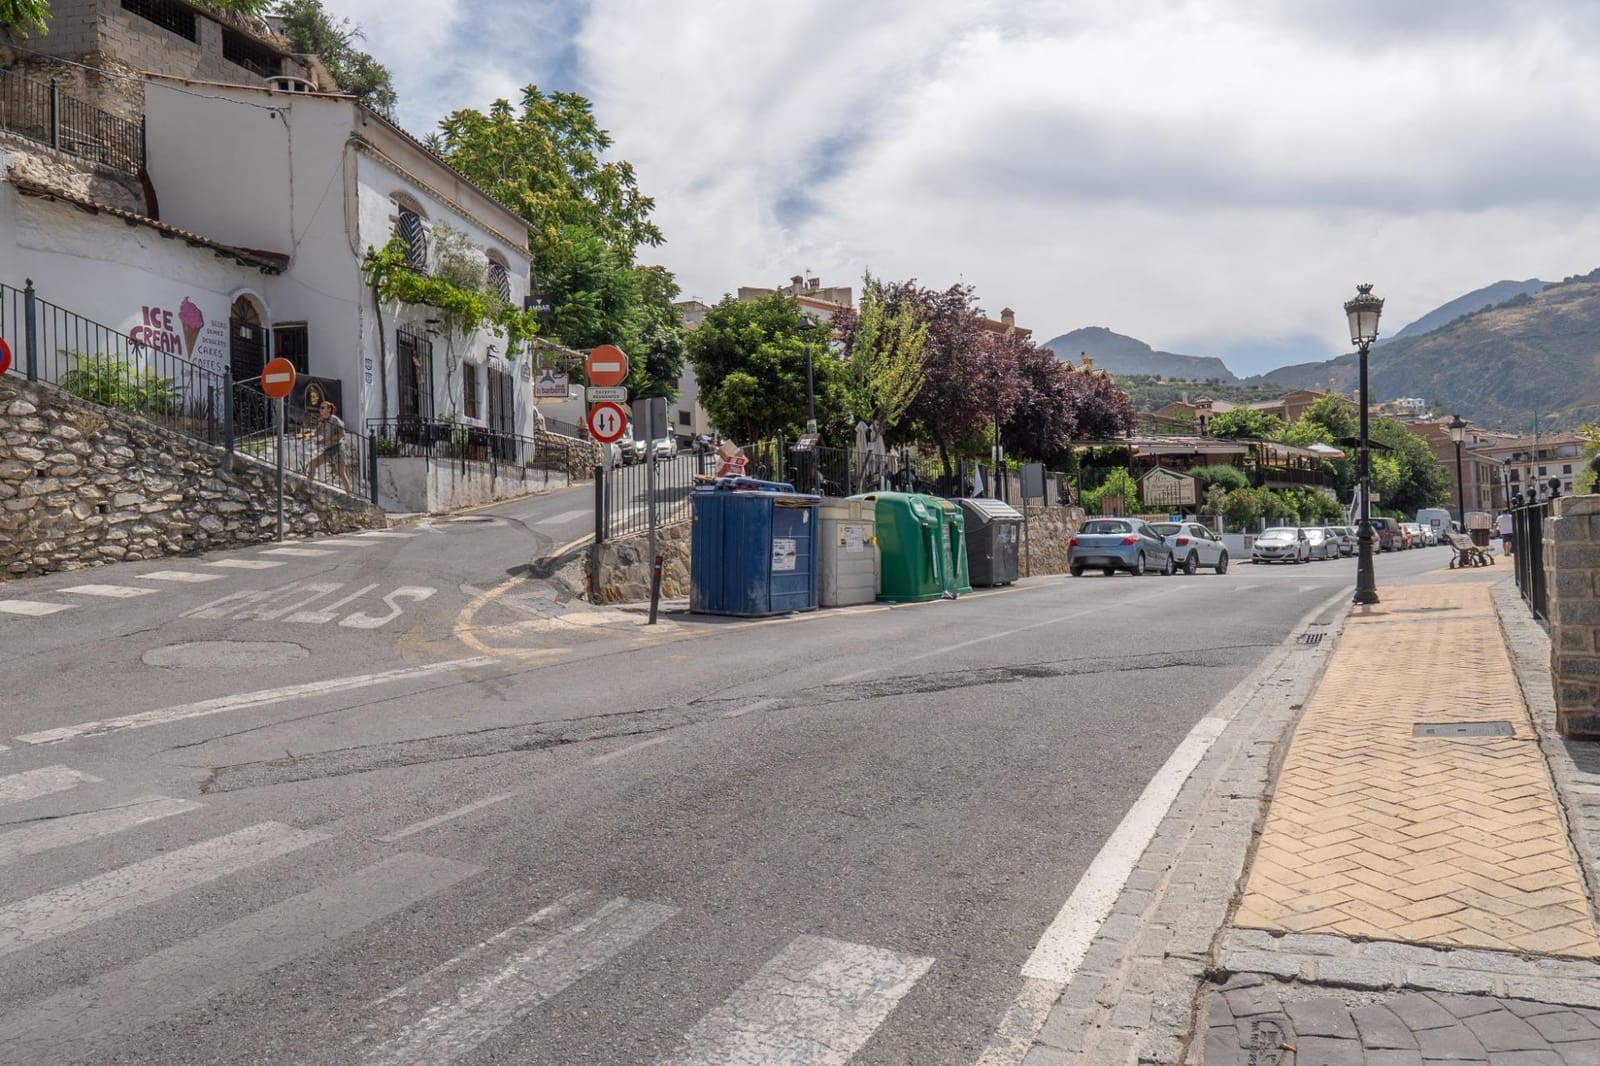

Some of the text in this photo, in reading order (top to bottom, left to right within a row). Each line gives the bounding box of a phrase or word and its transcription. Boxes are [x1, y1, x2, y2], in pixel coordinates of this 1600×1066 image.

[142, 306, 174, 332] ICE
[129, 325, 182, 355] CREAM
[197, 345, 223, 358] CAKES
